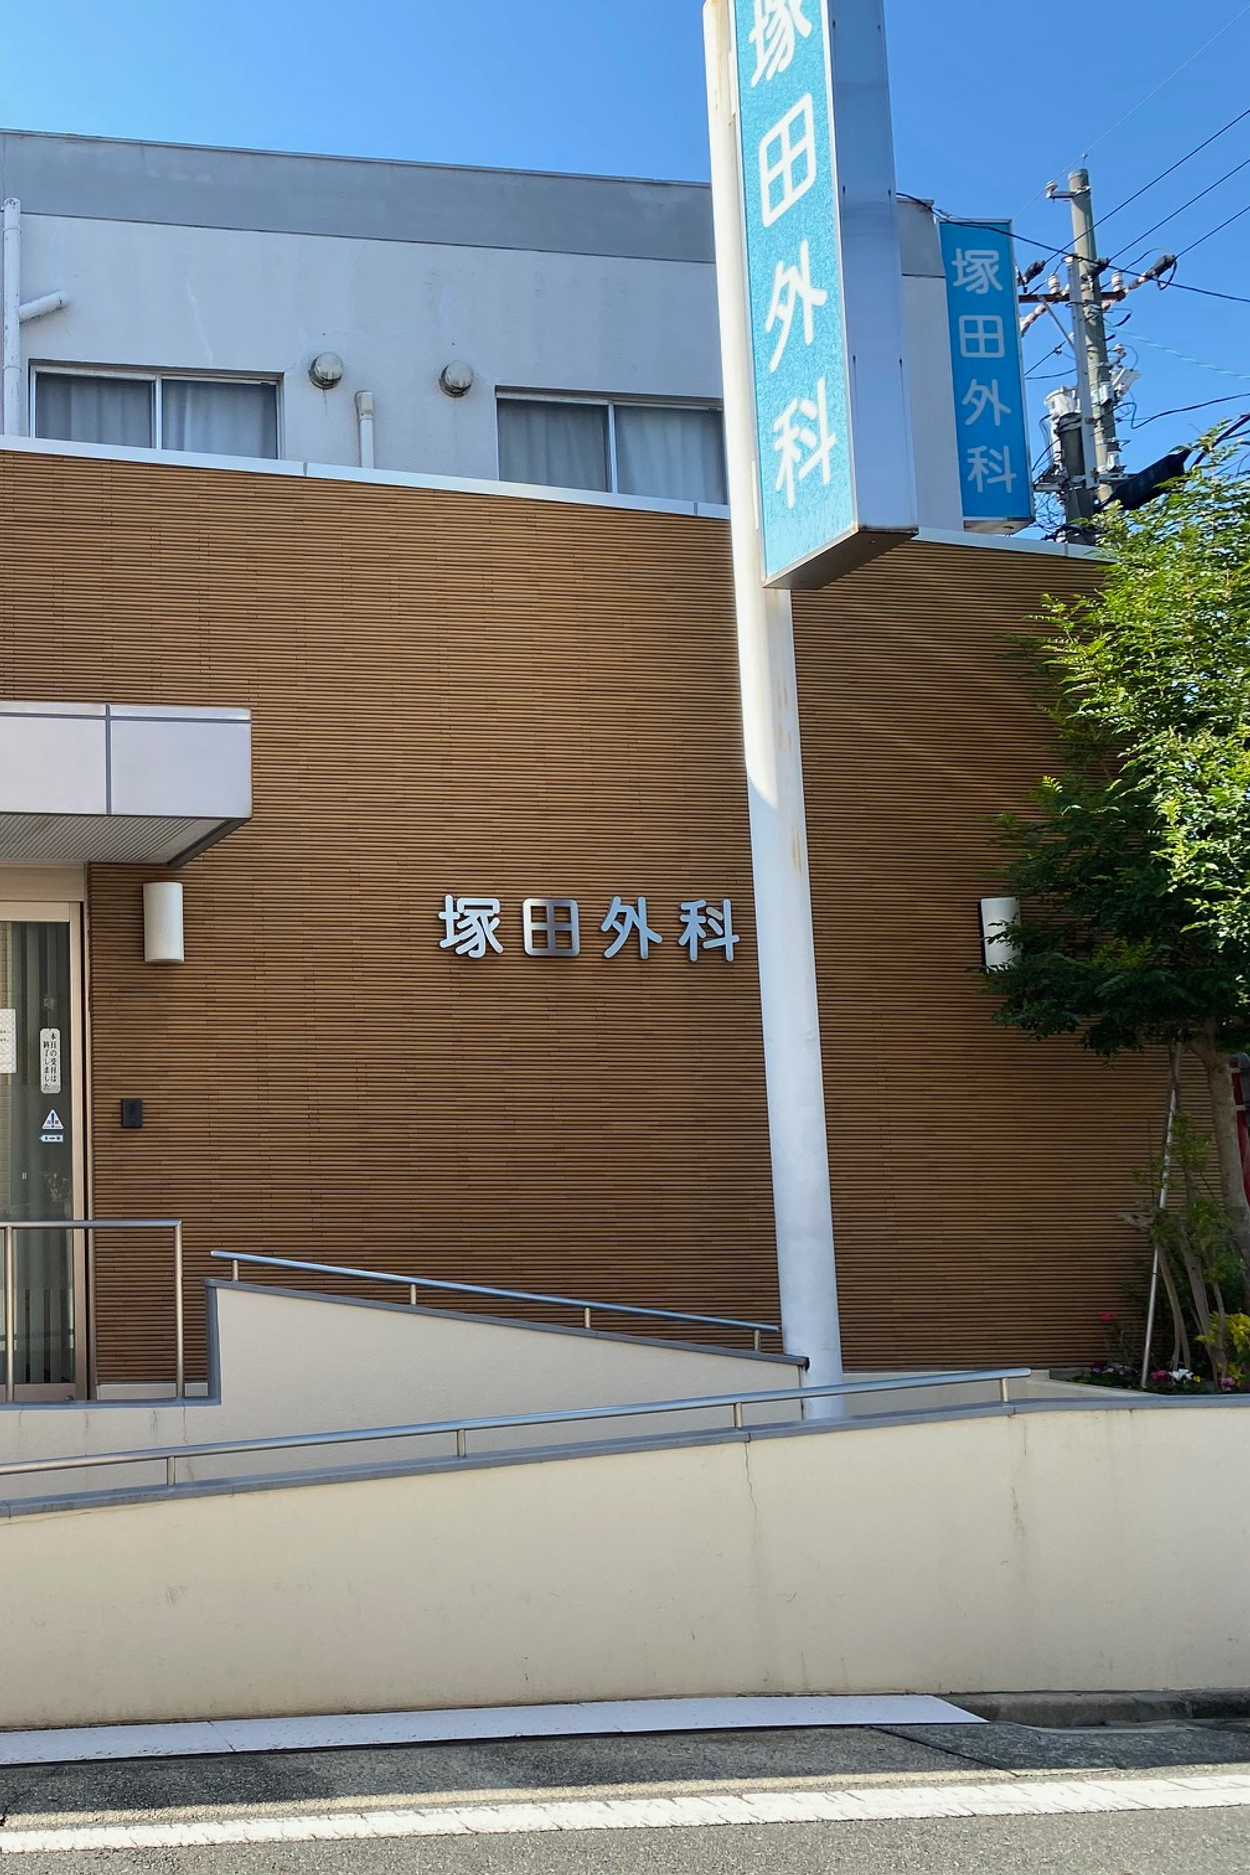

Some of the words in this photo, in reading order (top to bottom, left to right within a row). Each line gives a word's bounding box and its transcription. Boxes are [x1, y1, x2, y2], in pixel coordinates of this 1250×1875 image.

[748, 0, 837, 509] 塚田外科
[950, 247, 1018, 495] 塚田外科
[437, 894, 741, 962] 塚田外科
